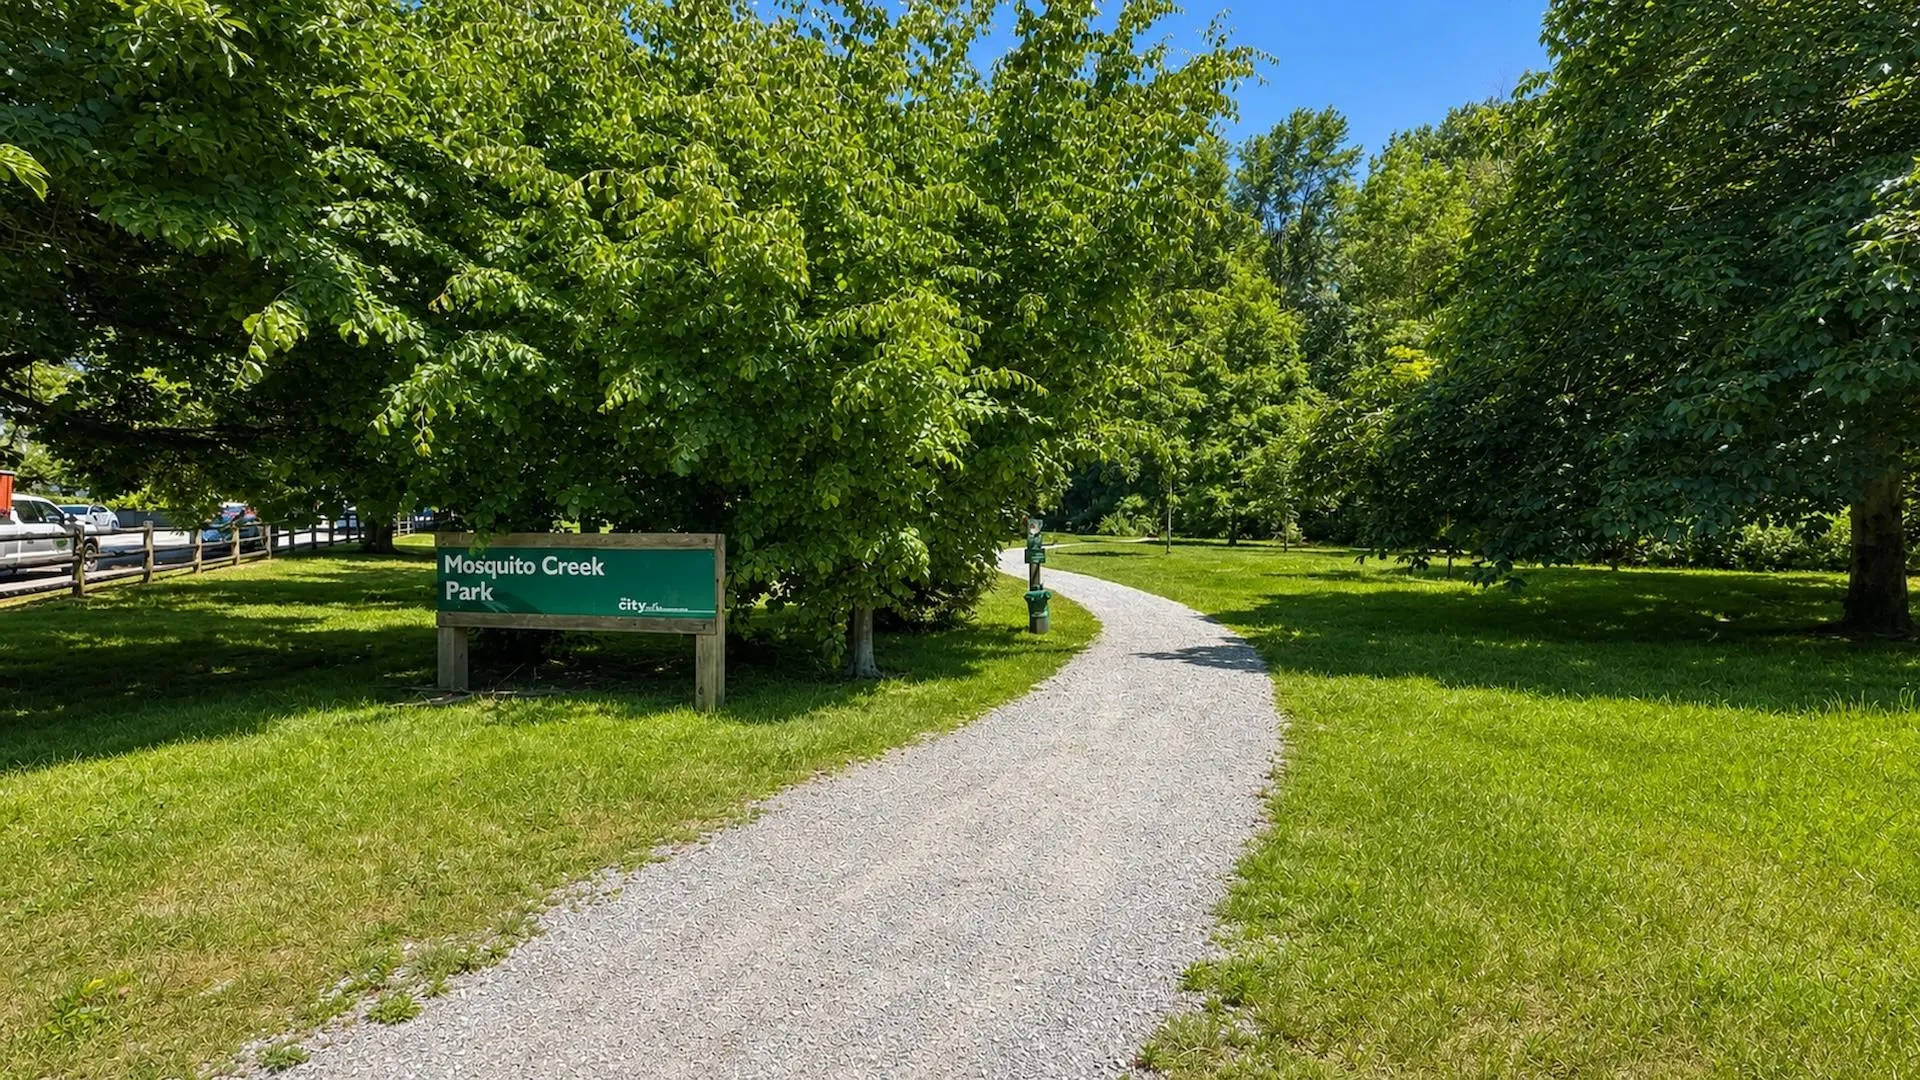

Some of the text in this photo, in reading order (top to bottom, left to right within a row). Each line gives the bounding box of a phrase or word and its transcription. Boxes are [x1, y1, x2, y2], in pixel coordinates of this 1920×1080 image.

[444, 554, 605, 580] Mosquito Creek
[445, 580, 494, 601] Park
[618, 598, 647, 613] city
